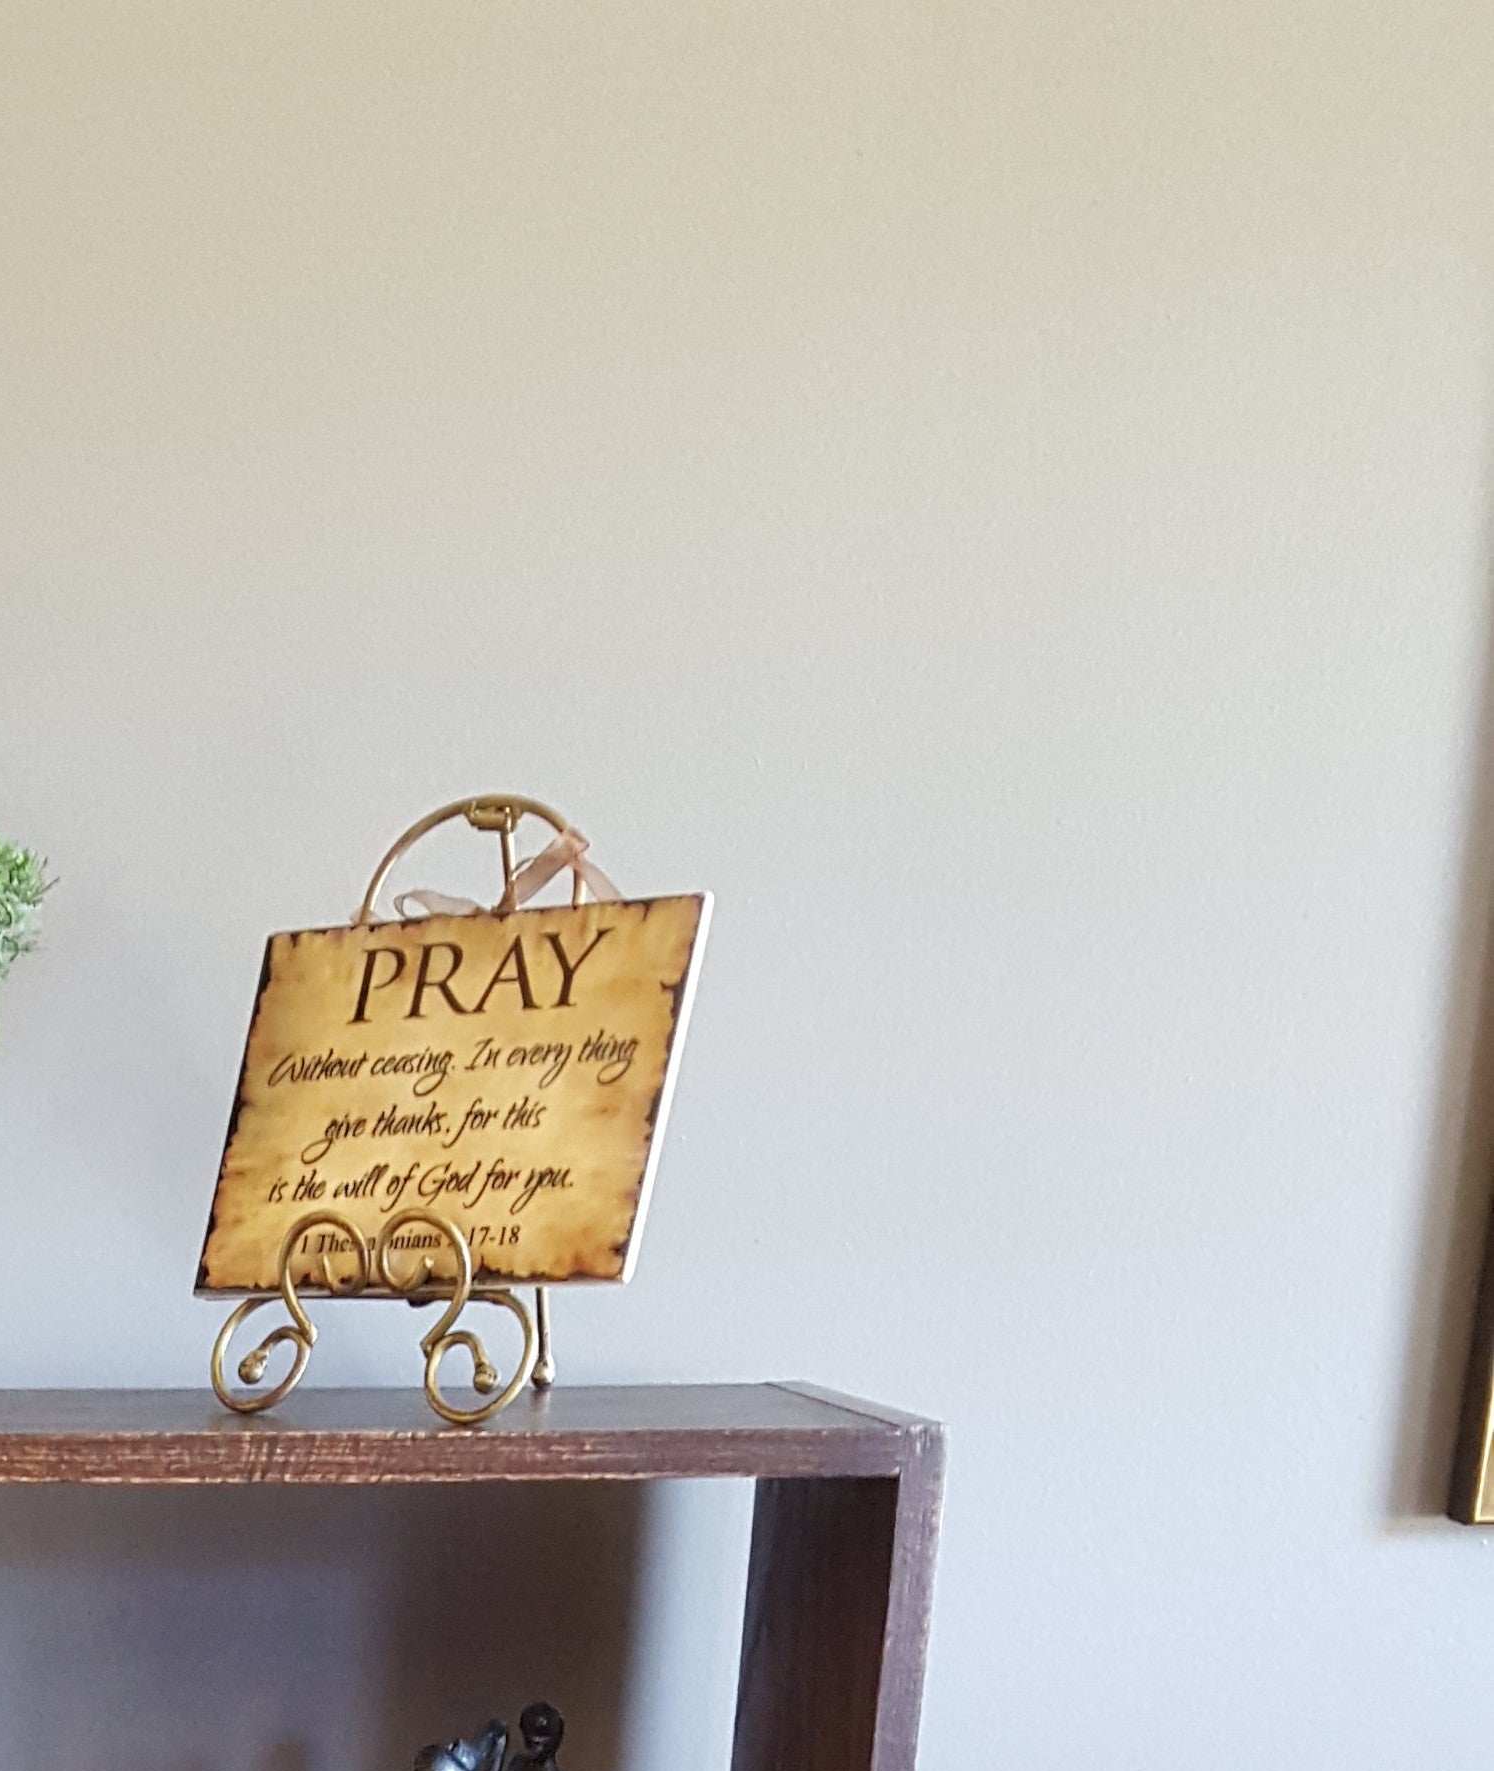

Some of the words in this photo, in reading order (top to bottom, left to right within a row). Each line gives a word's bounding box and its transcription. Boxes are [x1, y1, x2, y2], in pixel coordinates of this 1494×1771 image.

[347, 927, 615, 1026] PRAY
[268, 1049, 370, 1087] Without
[464, 1037, 502, 1071] In
[507, 1045, 572, 1089] every
[578, 1029, 639, 1086] thing
[301, 1114, 366, 1164] give
[442, 1099, 498, 1149] for
[502, 1096, 547, 1129] this
[268, 1180, 285, 1203] is
[292, 1169, 326, 1202] the
[333, 1165, 387, 1199] will
[380, 1163, 420, 1212] of
[417, 1160, 480, 1206] God
[463, 1158, 519, 1209] for
[511, 1172, 575, 1215] you.
